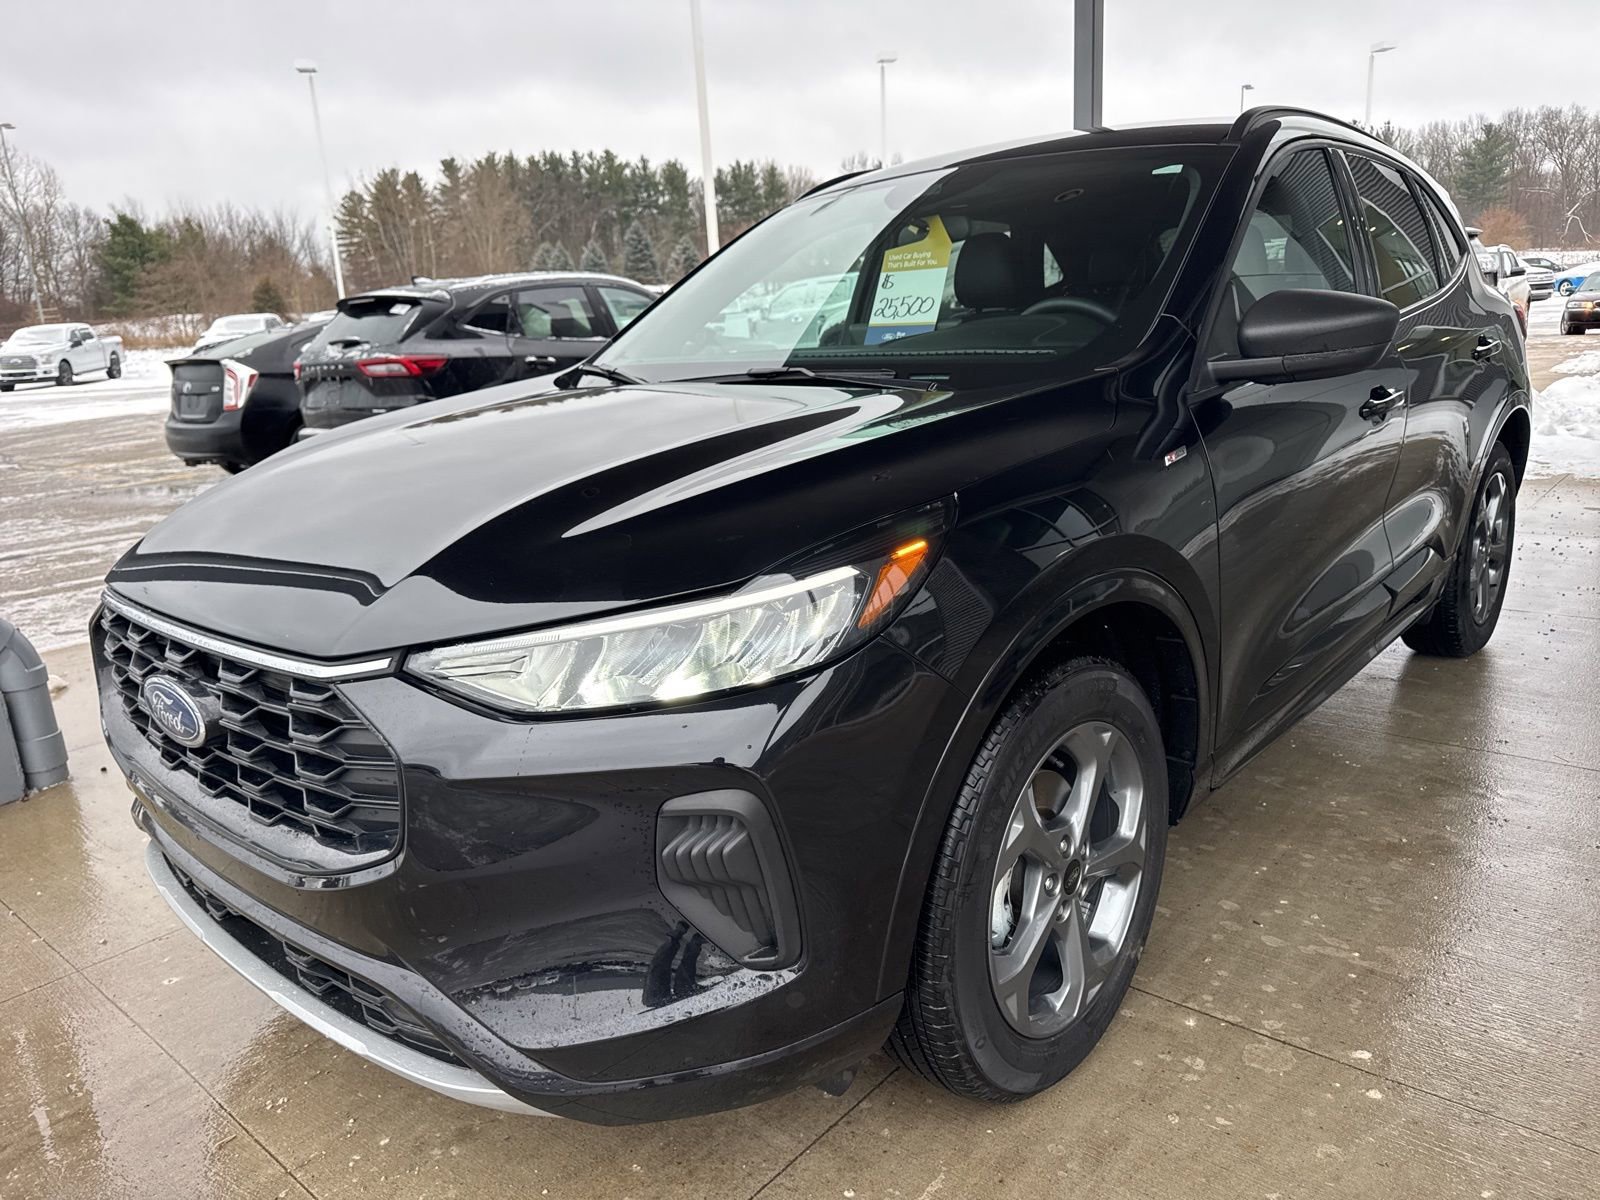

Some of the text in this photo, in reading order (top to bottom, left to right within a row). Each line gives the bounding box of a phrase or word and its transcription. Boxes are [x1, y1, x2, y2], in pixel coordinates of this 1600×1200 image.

[913, 252, 931, 260] Buying
[874, 295, 935, 320] 25,500
[152, 691, 194, 733] Ford
